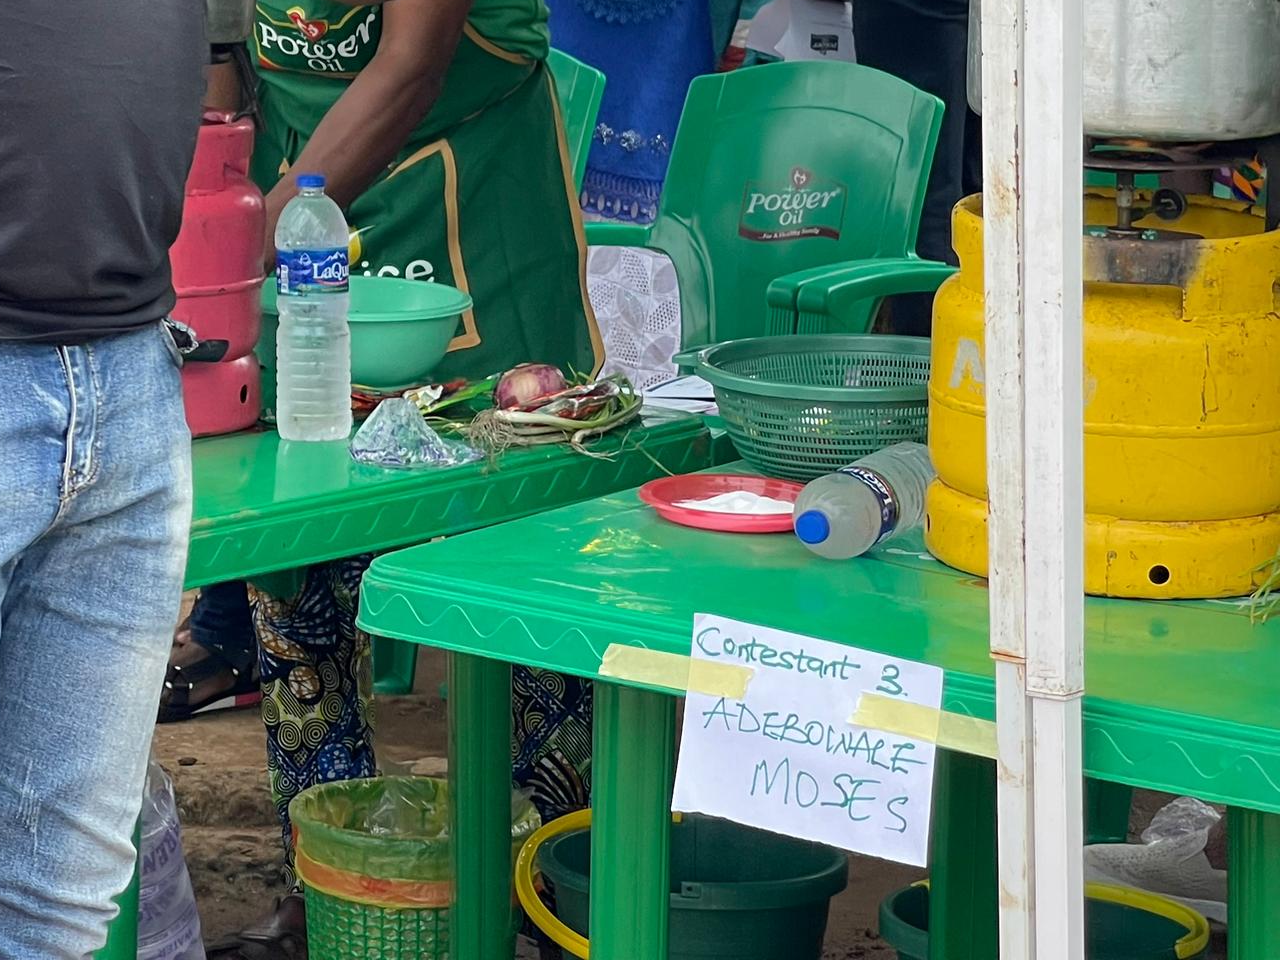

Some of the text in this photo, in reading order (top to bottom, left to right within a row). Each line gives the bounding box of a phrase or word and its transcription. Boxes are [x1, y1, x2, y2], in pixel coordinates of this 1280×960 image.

[259, 13, 376, 59] Power
[307, 59, 346, 71] Oil
[746, 190, 836, 213] Power
[779, 210, 803, 226] Oil
[696, 627, 861, 680] Contestant
[750, 757, 909, 833] MOSES
